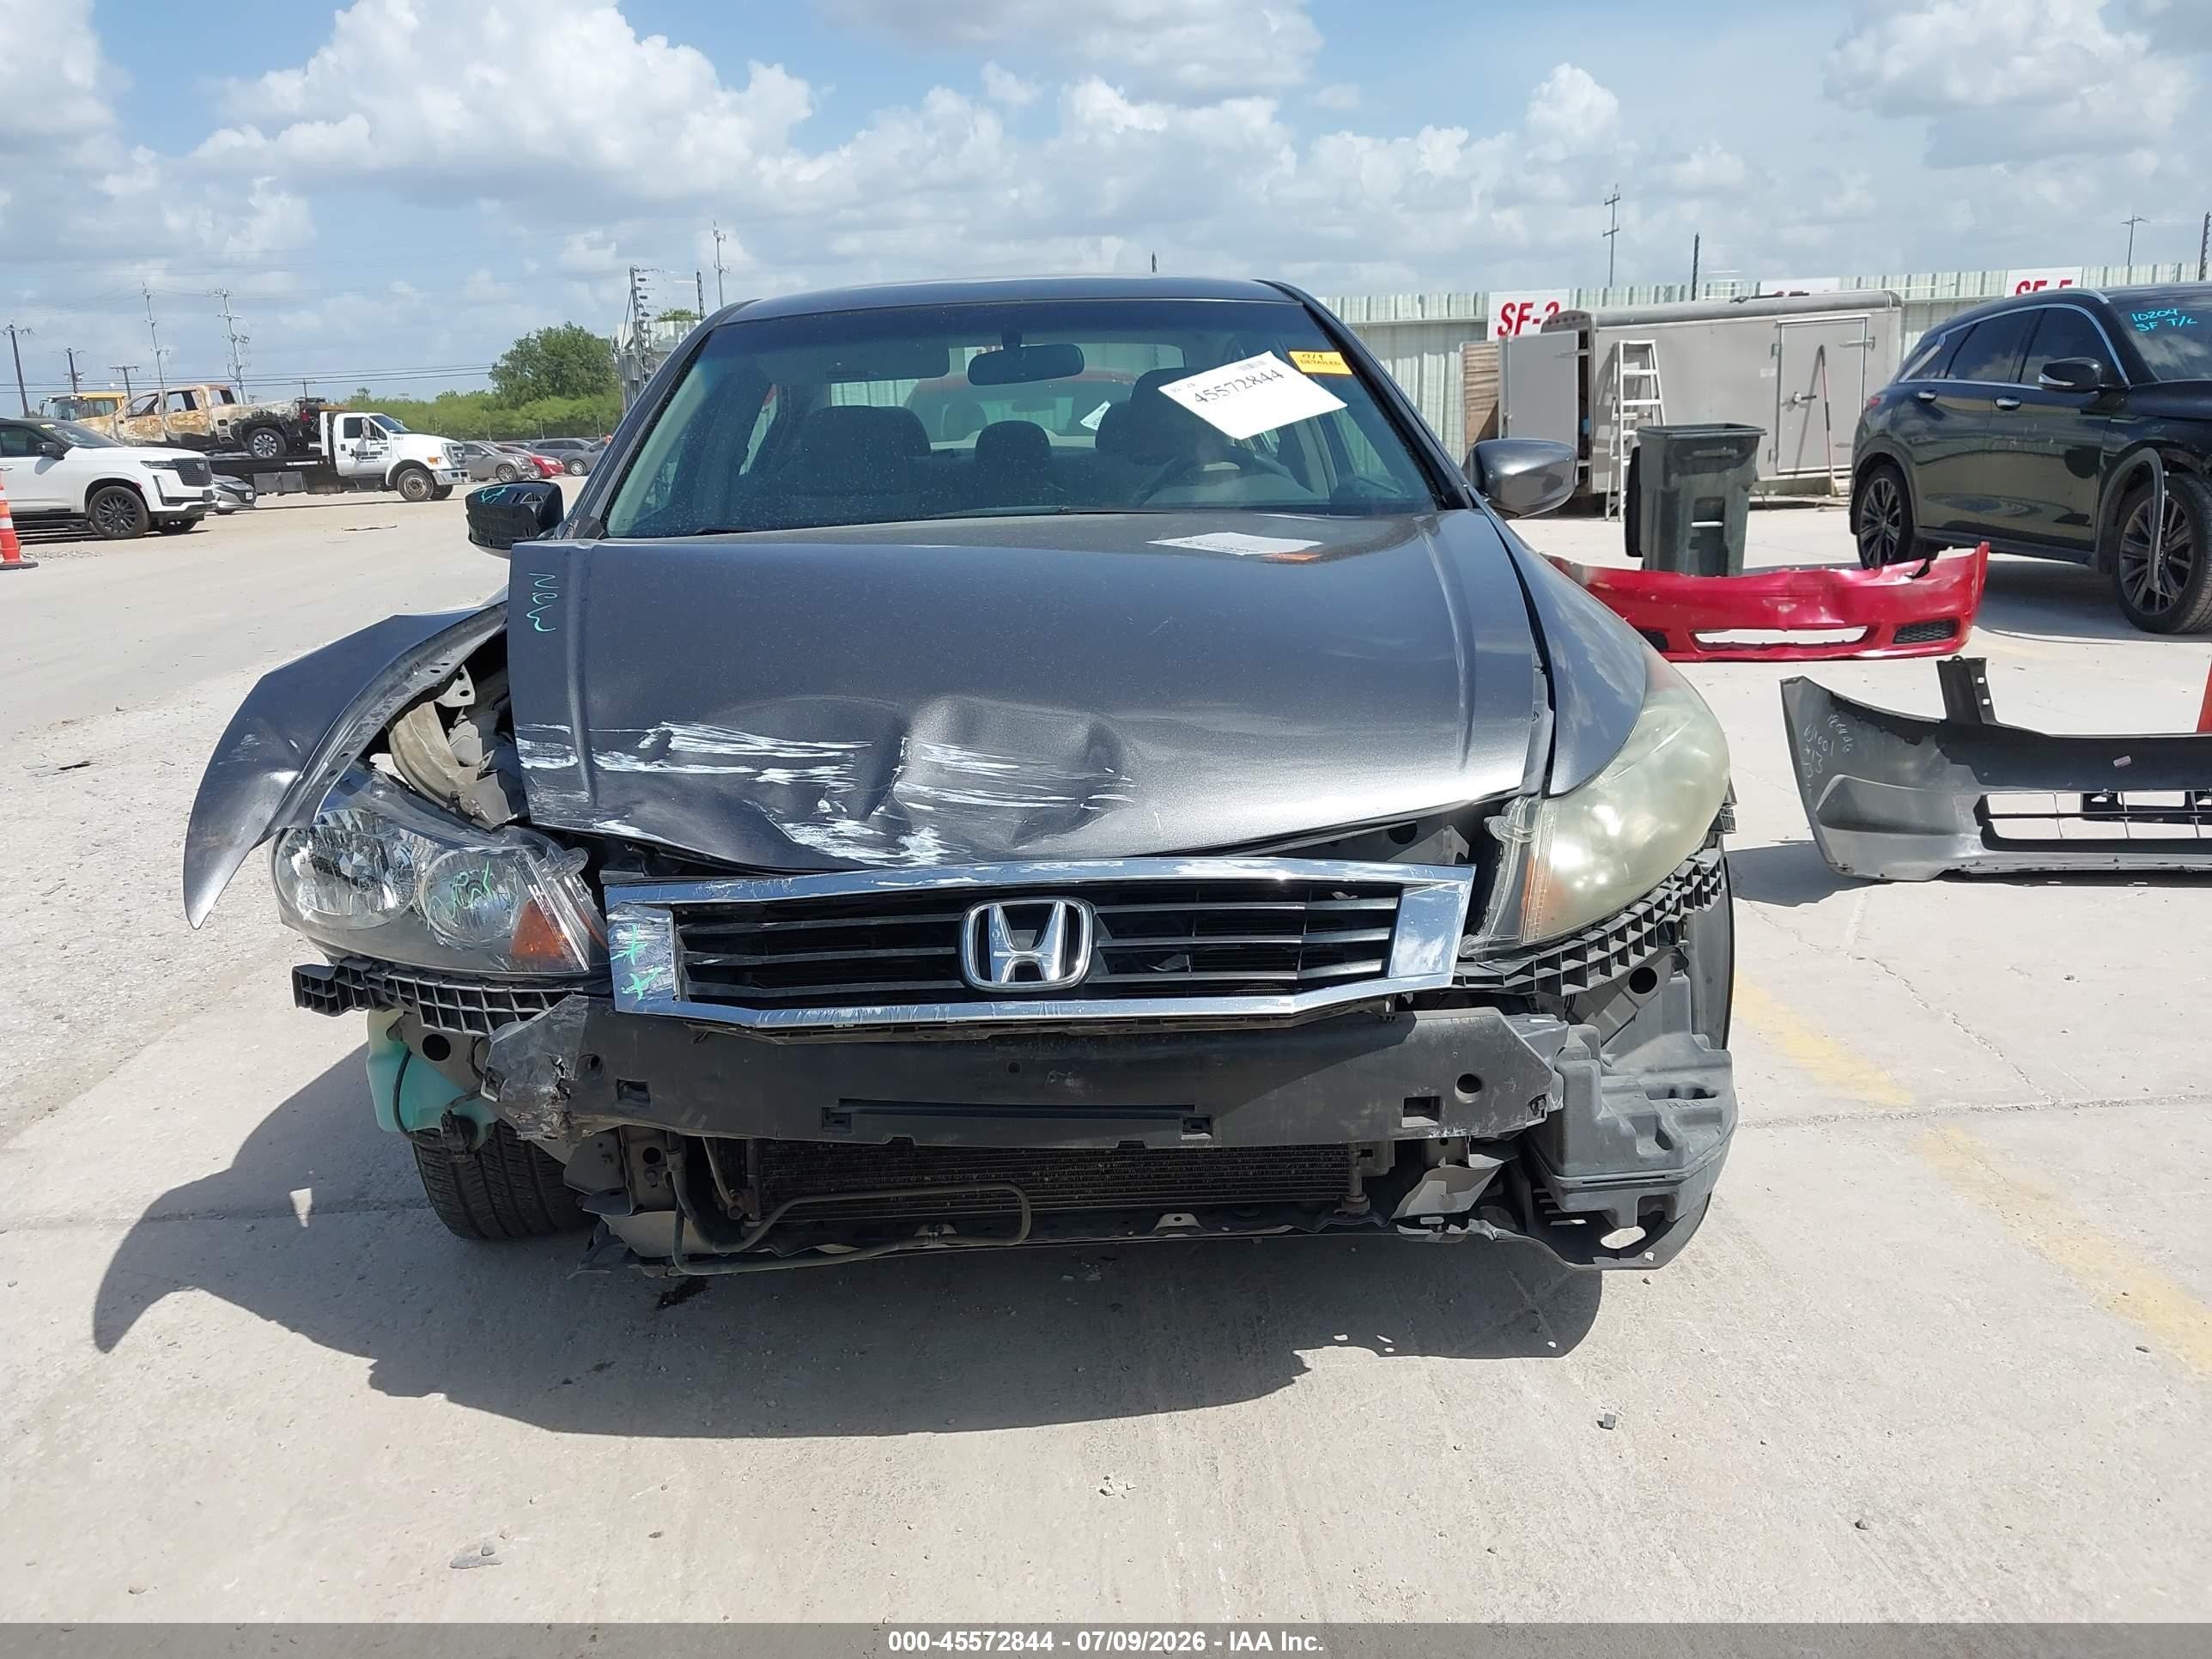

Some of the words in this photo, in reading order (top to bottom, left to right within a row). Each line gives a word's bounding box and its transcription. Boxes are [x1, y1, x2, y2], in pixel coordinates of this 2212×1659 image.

[2131, 308, 2179, 322] 10204
[2136, 322, 2159, 331] SF
[1194, 368, 1285, 404] 45572844
